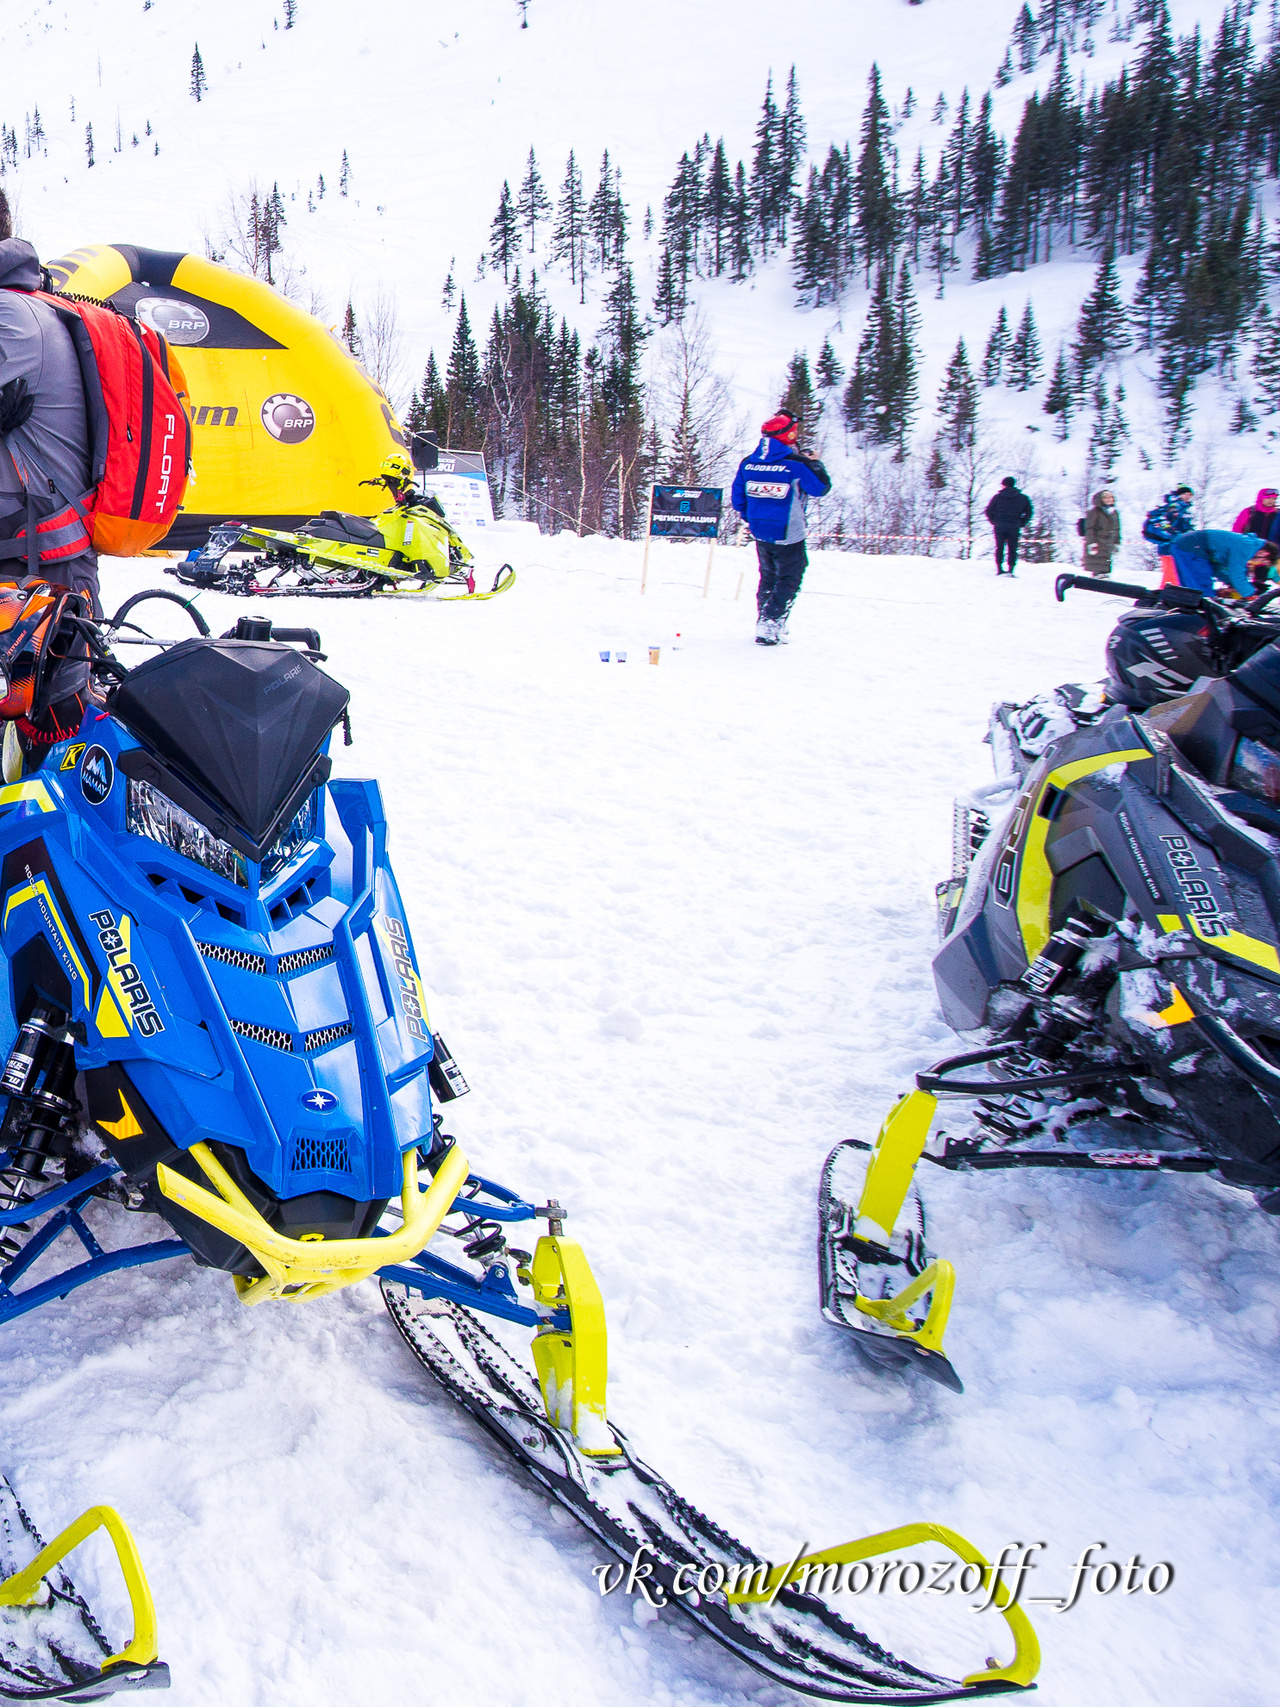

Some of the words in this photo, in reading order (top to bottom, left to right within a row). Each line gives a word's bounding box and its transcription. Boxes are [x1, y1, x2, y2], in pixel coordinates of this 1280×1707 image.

[168, 319, 207, 331] BRP
[155, 414, 175, 514] FLOAT
[283, 418, 313, 429] BRP
[652, 514, 718, 524] РЕГИСТРАЦИЯ
[263, 662, 304, 695] POLARIS
[1118, 811, 1133, 836] ROCKY
[1128, 836, 1151, 878] MOUNTAIN
[1146, 877, 1161, 900] KING
[1158, 834, 1231, 937] POLARIS
[24, 863, 40, 897] ROCKY
[36, 897, 64, 952] MOUNTAIN
[62, 951, 79, 982] KING
[88, 908, 166, 1038] POLARIS
[383, 914, 428, 1043] POLARIS
